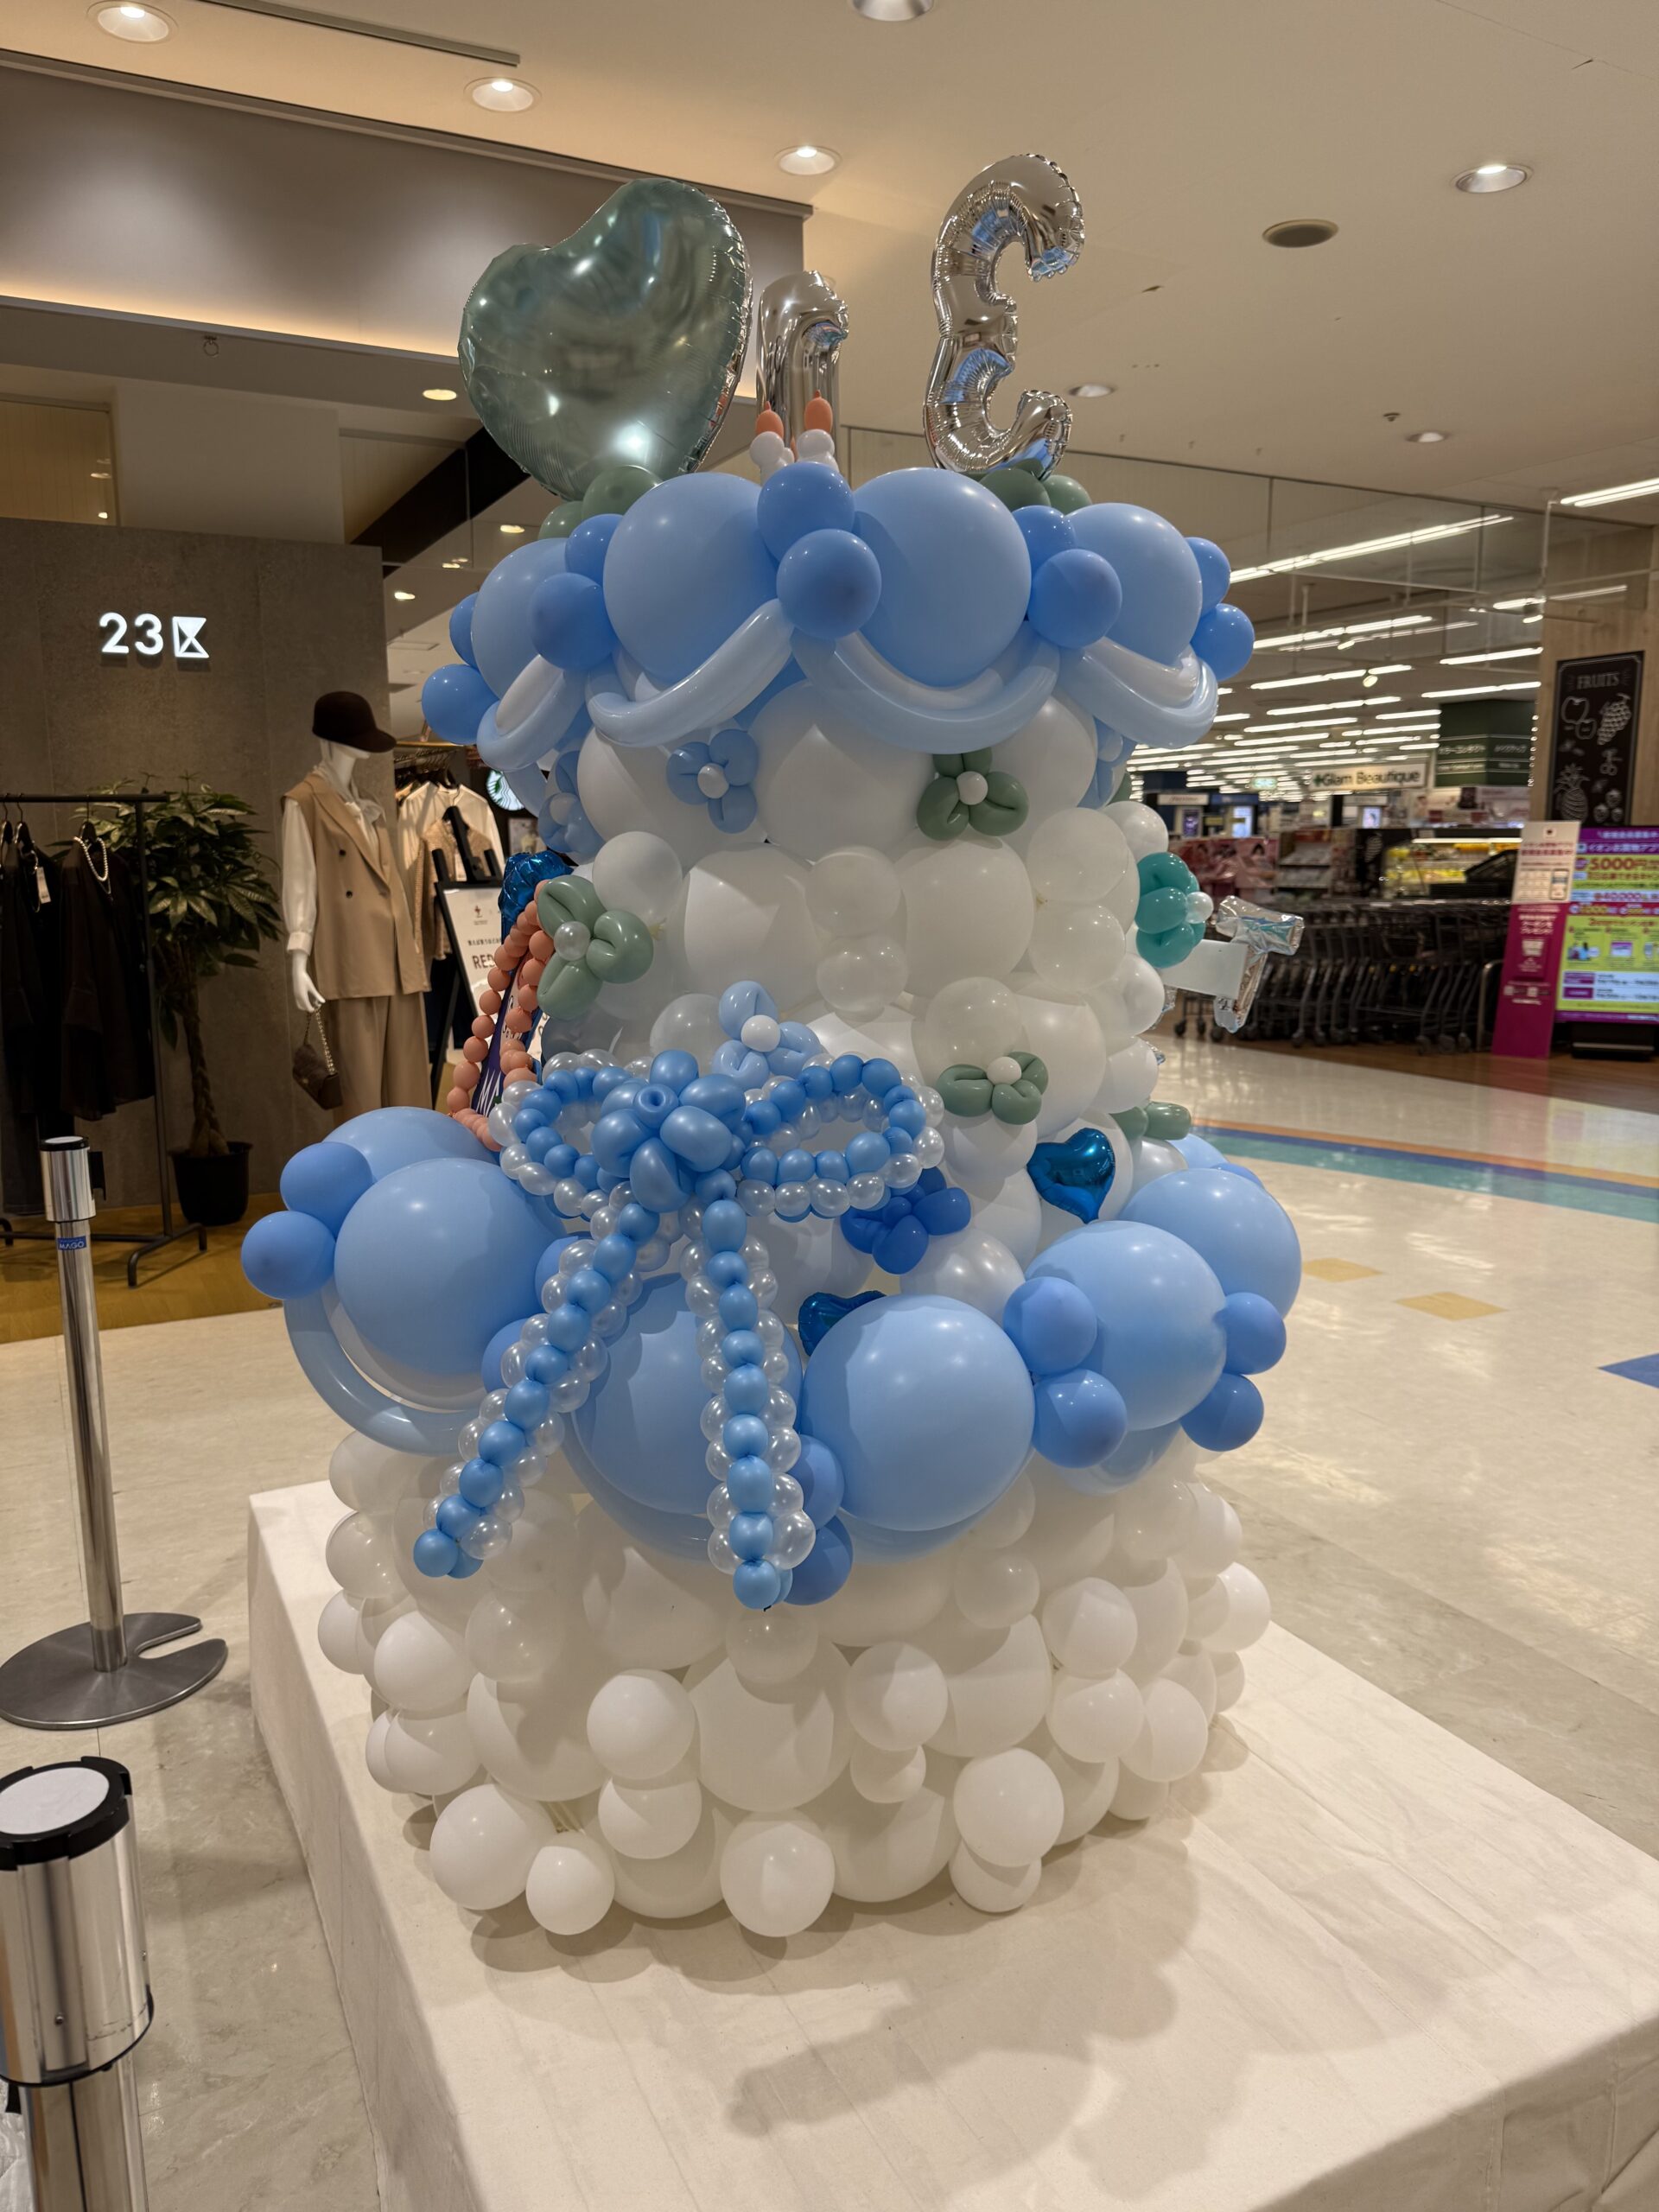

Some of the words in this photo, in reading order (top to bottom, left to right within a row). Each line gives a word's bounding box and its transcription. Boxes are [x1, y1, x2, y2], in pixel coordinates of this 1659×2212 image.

[1577, 672, 1620, 690] FRUITS
[1322, 772, 1352, 786] Glam
[59, 1241, 85, 1249] MAGO
